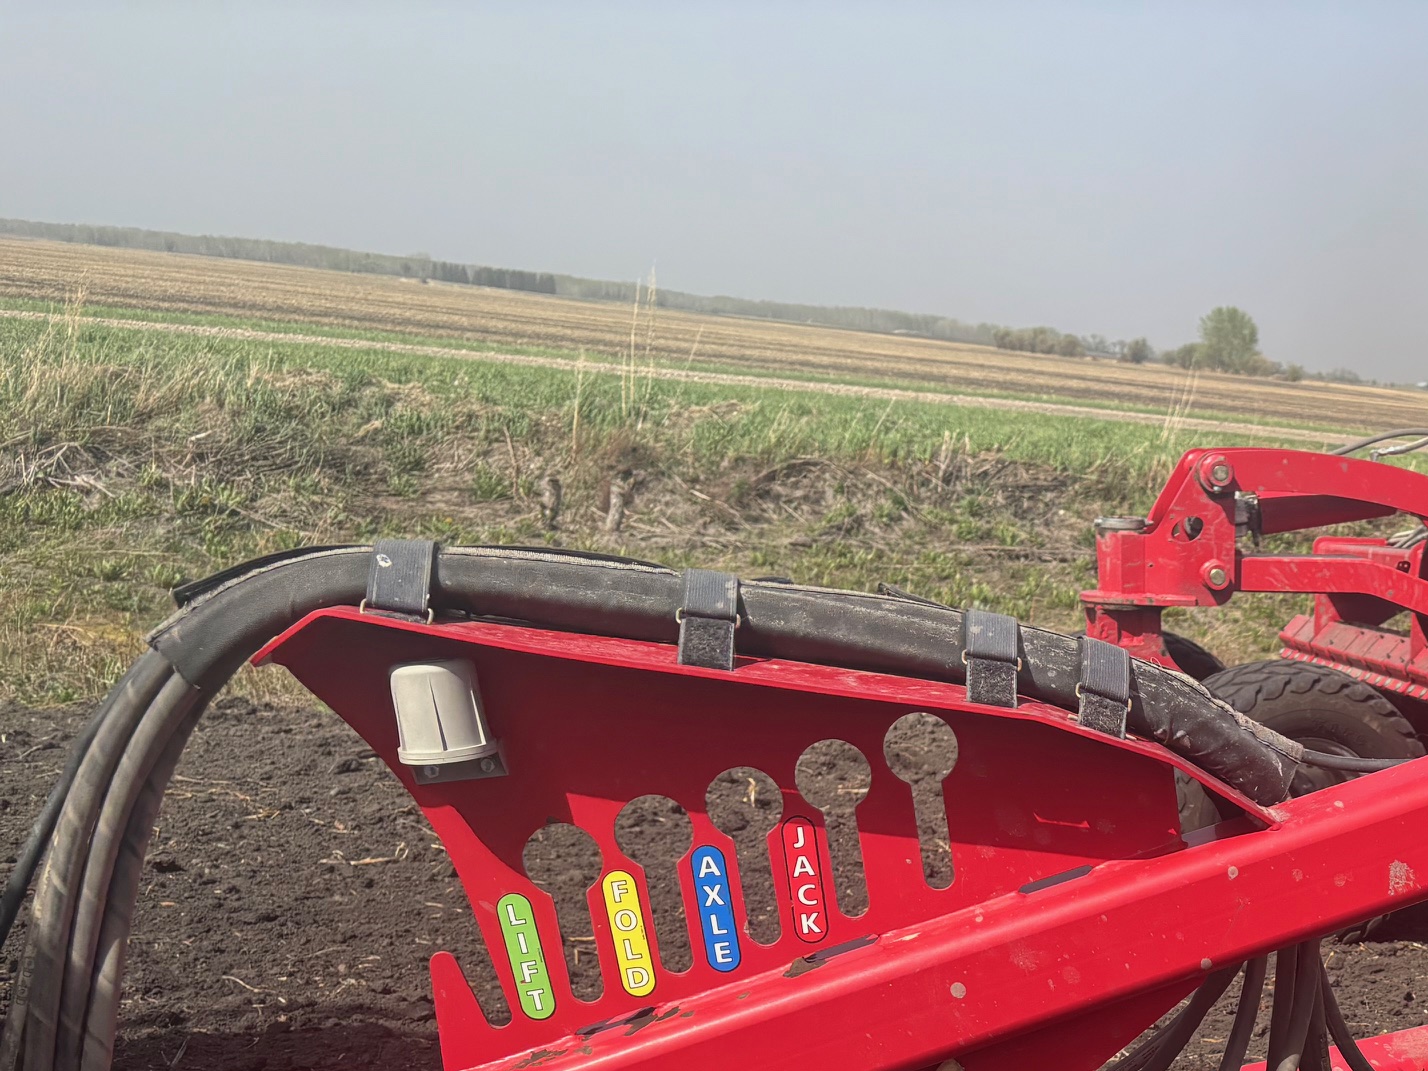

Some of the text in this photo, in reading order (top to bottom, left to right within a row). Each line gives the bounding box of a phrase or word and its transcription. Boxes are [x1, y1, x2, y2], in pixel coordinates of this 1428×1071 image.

[610, 879, 651, 989] FOLD
[698, 855, 734, 964] AXLE
[793, 826, 822, 934] JACK
[505, 904, 544, 1012] LIFT
